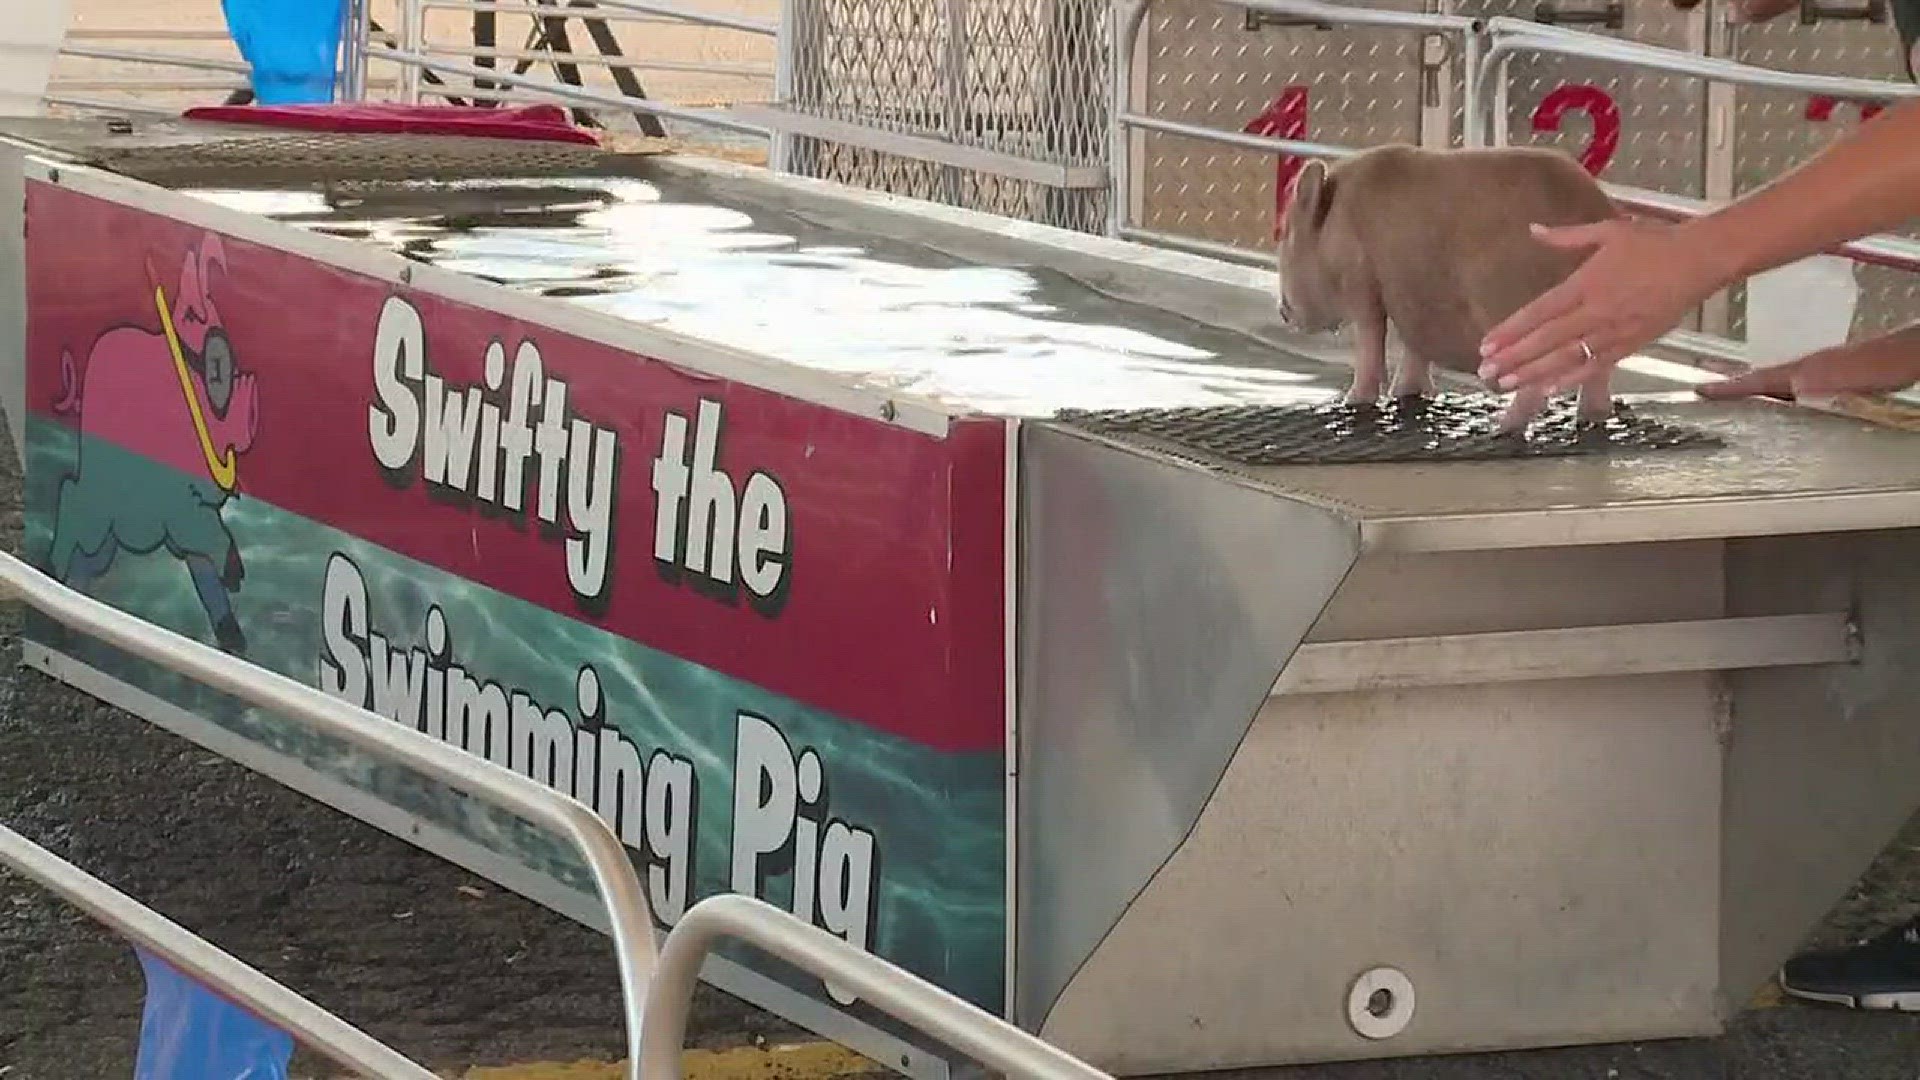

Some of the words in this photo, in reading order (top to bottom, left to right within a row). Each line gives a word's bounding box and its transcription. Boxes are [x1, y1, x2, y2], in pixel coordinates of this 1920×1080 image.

[1244, 86, 1308, 240] 1
[368, 296, 617, 600] Swifty
[652, 398, 789, 599] the
[319, 552, 698, 928] Swimming
[730, 709, 876, 1005] Pig
